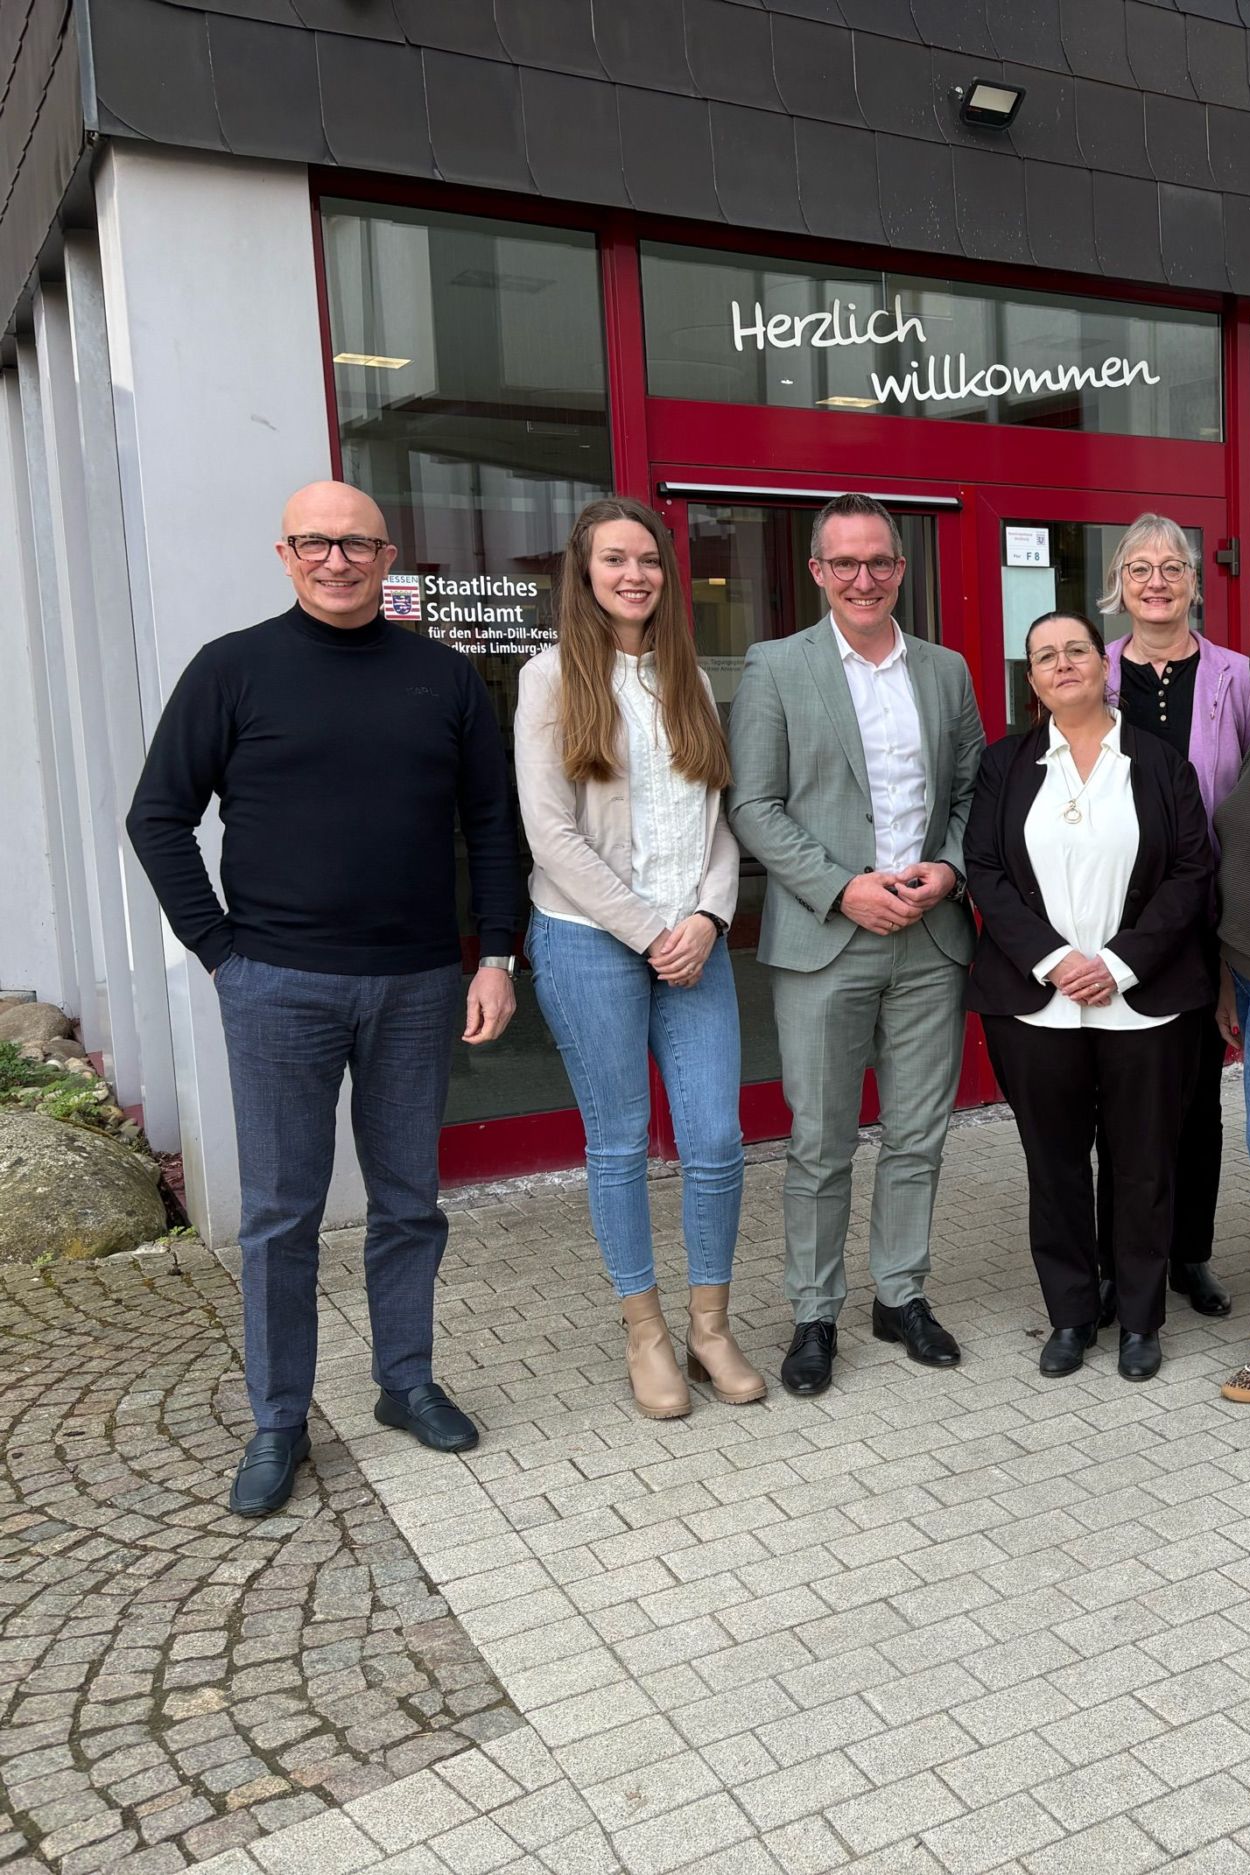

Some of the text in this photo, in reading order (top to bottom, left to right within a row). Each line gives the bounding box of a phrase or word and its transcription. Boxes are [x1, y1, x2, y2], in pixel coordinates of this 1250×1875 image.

[731, 294, 927, 351] Herzlich
[870, 353, 1161, 404] willkommen
[384, 575, 418, 583] ESSEN
[425, 575, 538, 597] Staatliches
[427, 602, 524, 623] Schulamt
[428, 626, 558, 639] für den Lahn-Dill-Kreis
